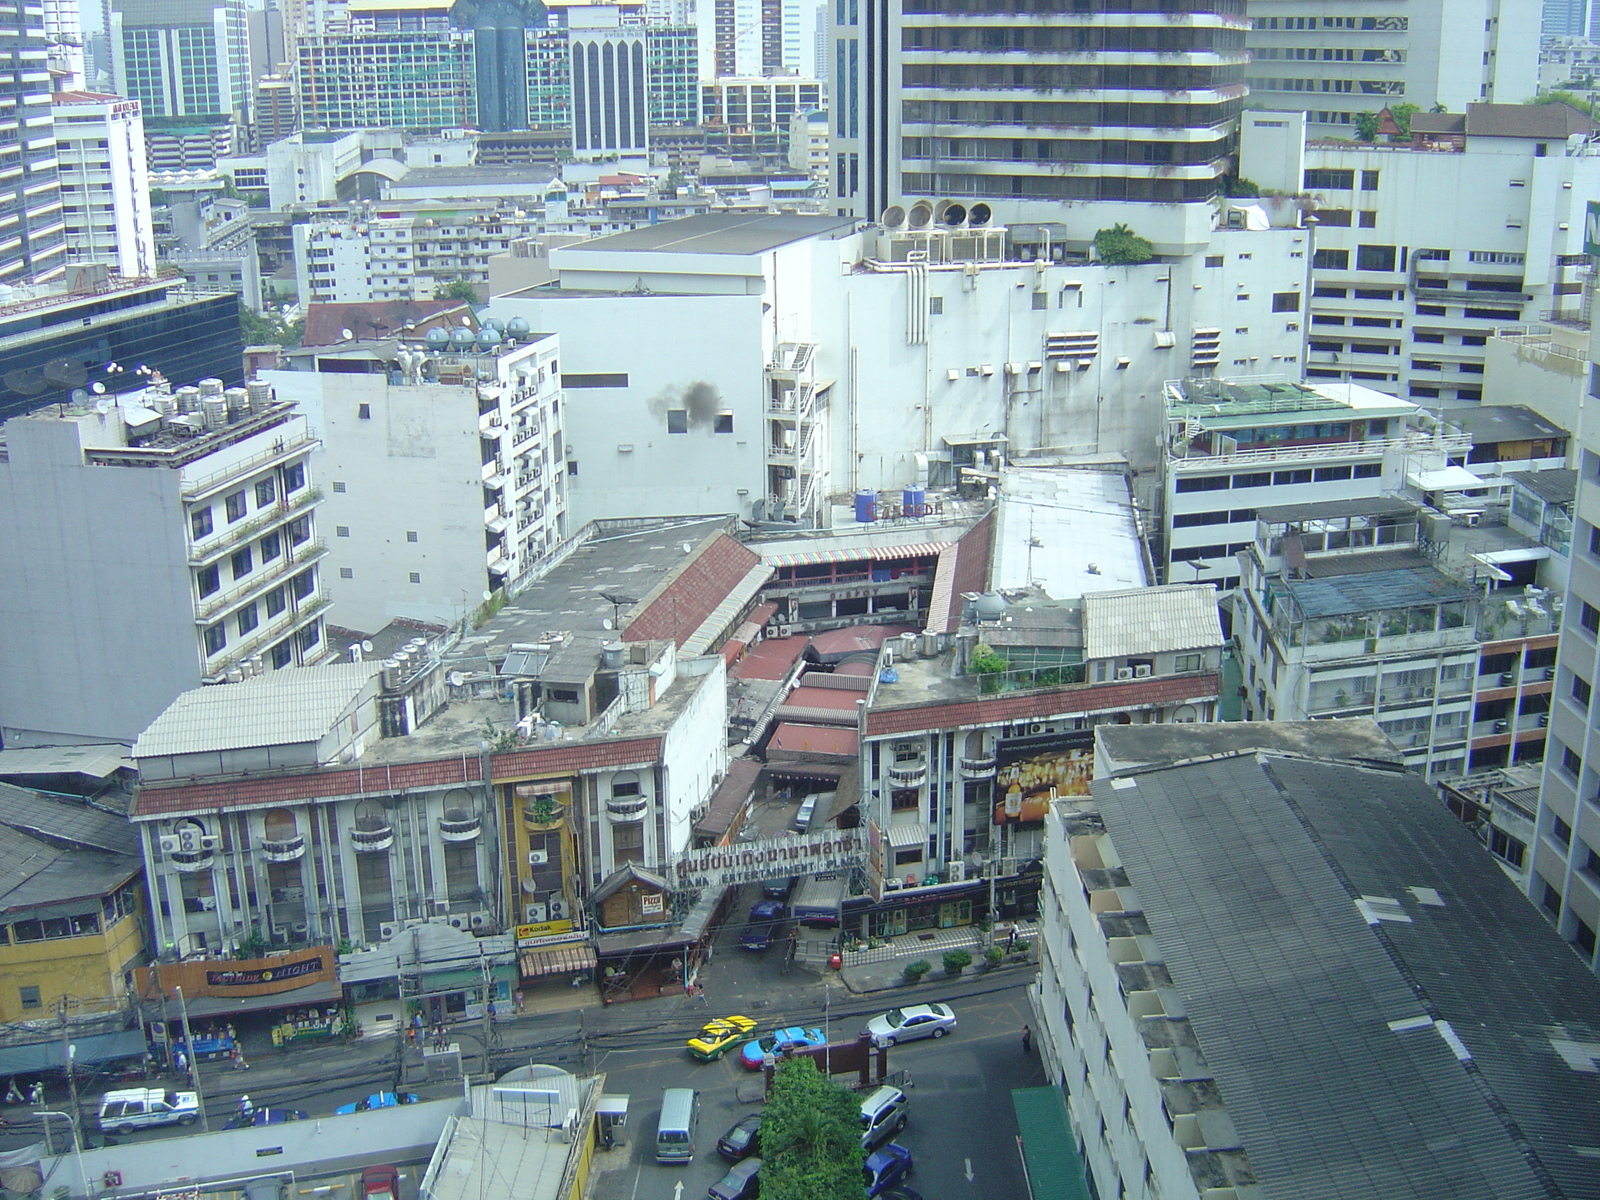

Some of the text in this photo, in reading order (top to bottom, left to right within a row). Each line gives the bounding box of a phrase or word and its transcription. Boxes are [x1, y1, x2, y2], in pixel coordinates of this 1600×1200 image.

[866, 501, 945, 520] CASCADE
[679, 876, 710, 889] NANA
[826, 856, 864, 871] PLAZA
[644, 896, 661, 905] Pizza
[529, 925, 552, 933] Kodak
[211, 973, 260, 983] Morning
